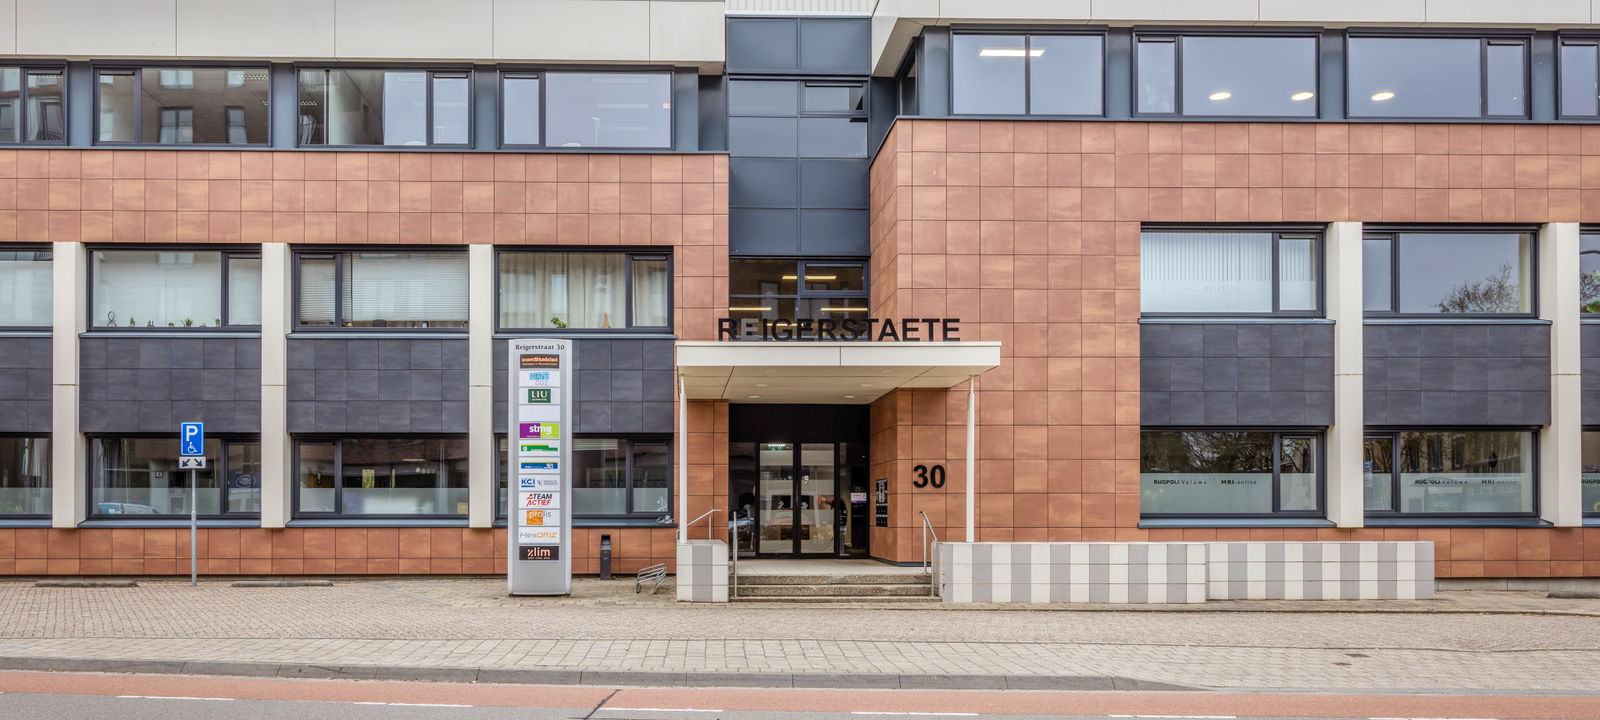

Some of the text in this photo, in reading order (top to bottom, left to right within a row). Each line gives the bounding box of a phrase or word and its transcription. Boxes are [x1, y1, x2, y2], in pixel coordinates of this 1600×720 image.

[718, 318, 961, 342] REIGERSTAETE
[531, 390, 548, 398] LIU
[186, 425, 198, 442] P
[529, 424, 552, 435] stmg
[912, 464, 946, 489] 30
[529, 511, 552, 519] prolis
